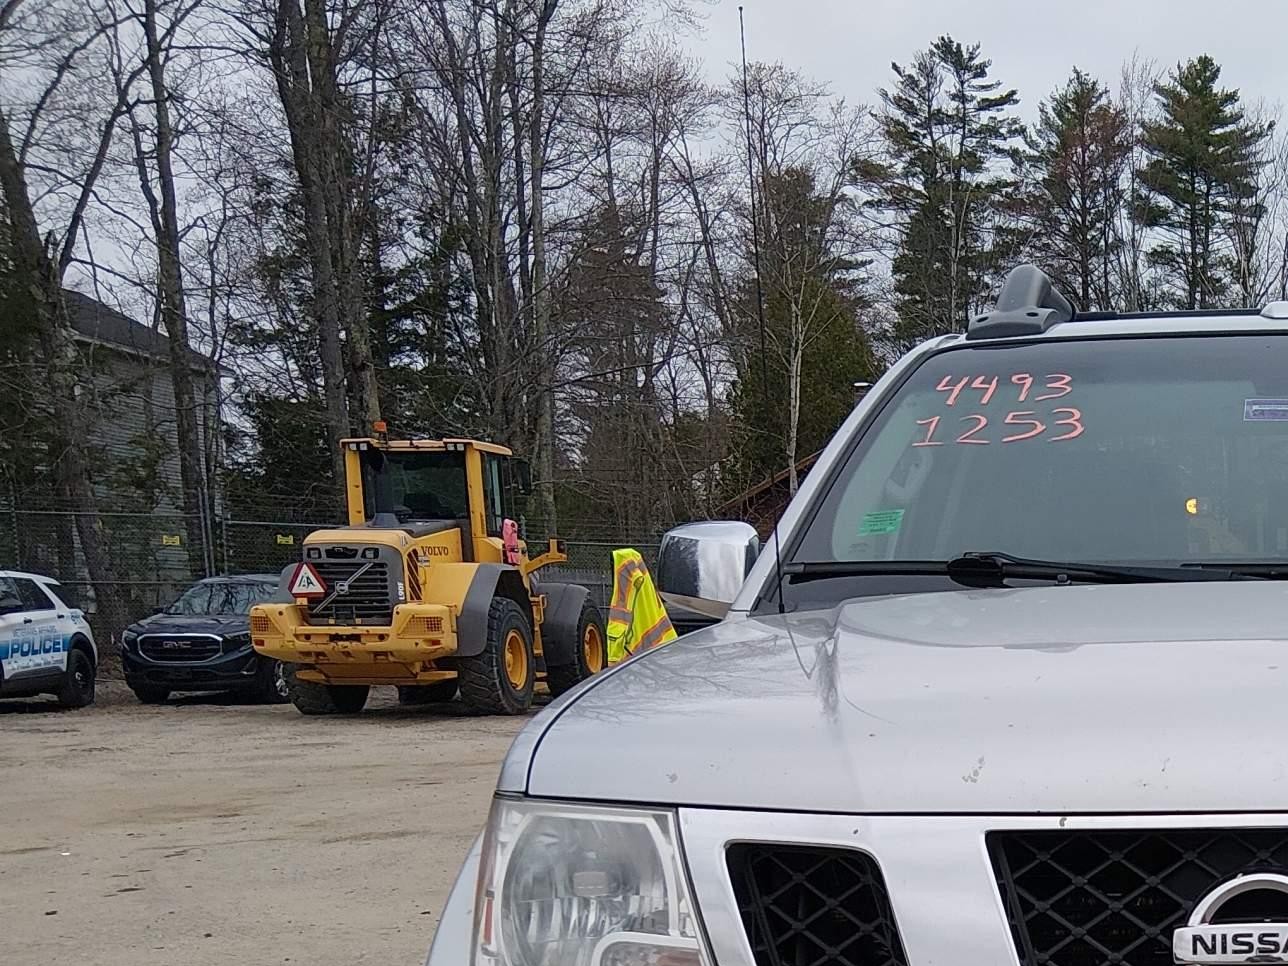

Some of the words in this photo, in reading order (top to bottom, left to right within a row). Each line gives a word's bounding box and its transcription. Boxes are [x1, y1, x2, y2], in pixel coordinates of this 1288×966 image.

[936, 372, 1073, 407] 4493
[911, 407, 1086, 448] 1253
[421, 545, 449, 556] VOLVO
[8, 632, 63, 660] POLICE
[162, 641, 192, 649] GMC
